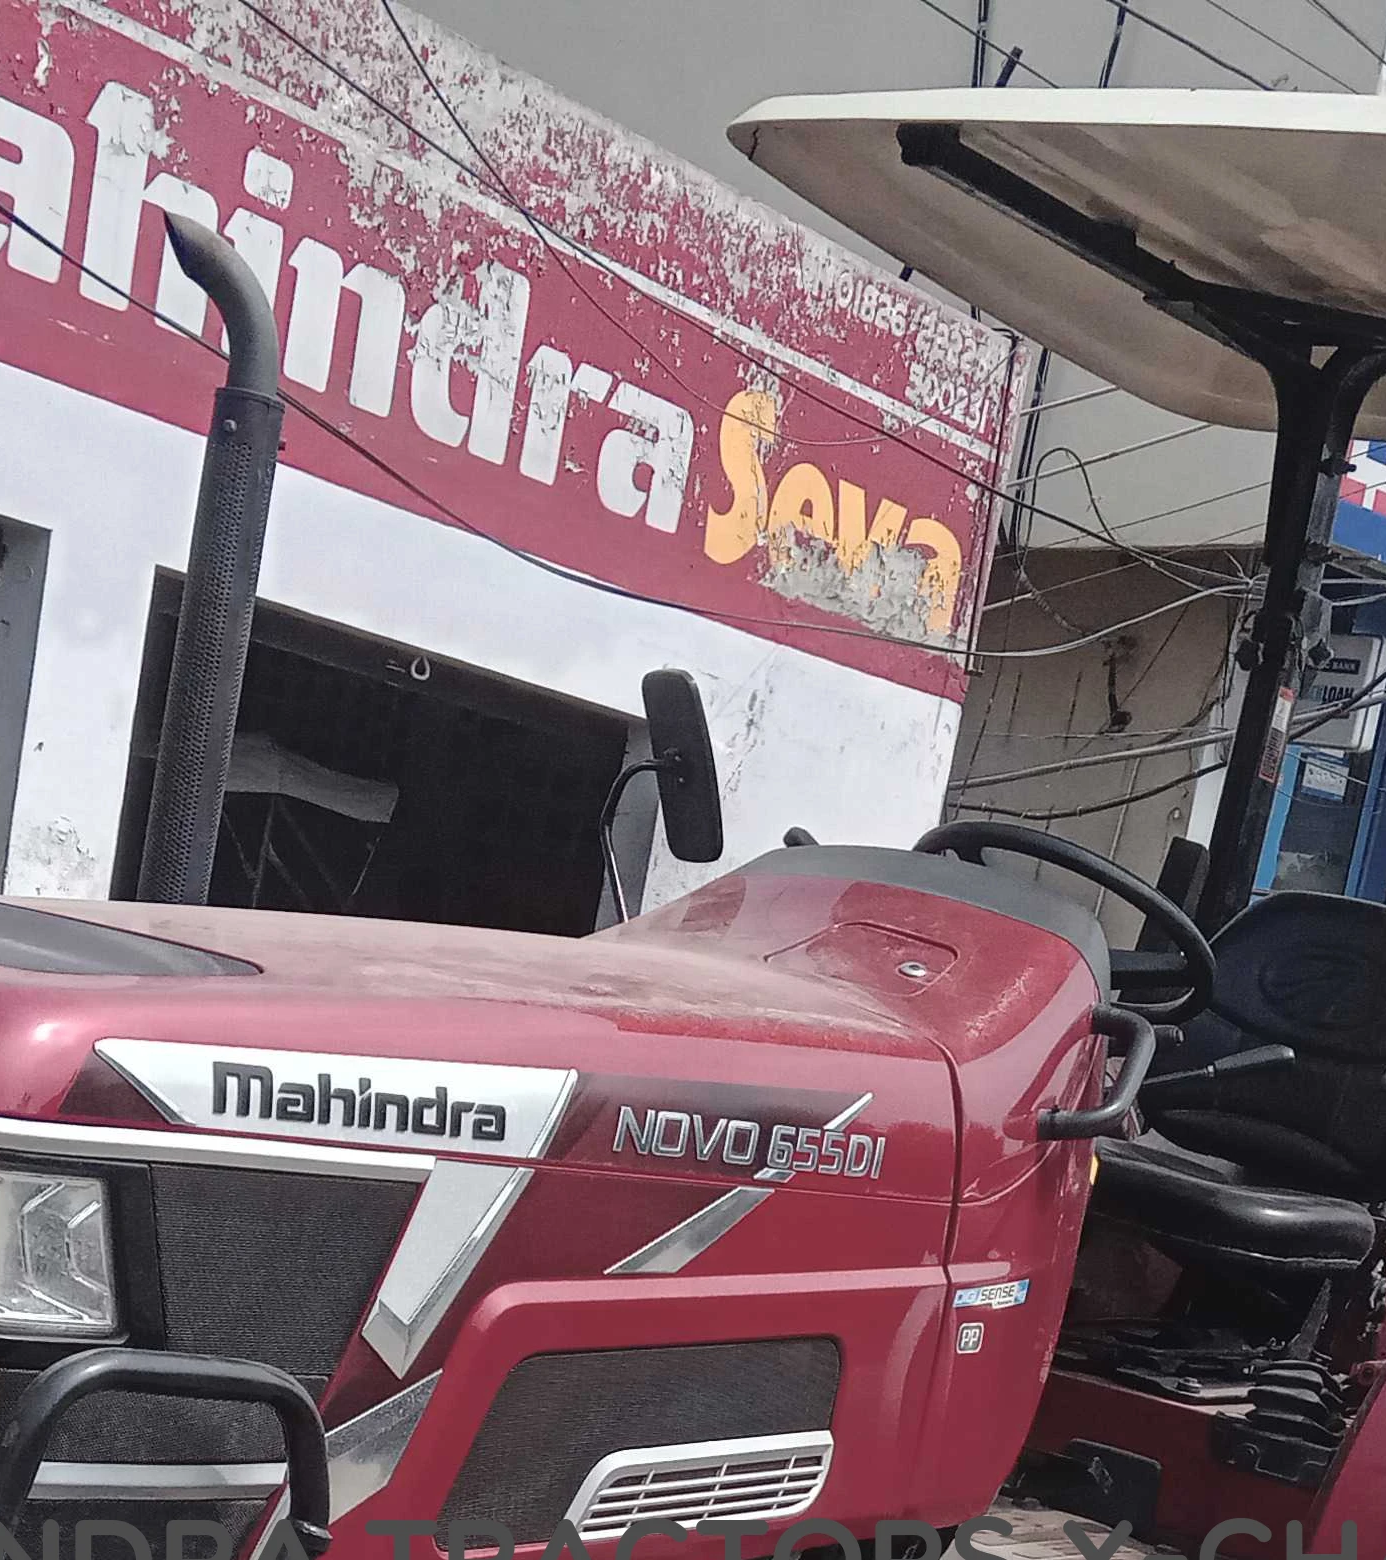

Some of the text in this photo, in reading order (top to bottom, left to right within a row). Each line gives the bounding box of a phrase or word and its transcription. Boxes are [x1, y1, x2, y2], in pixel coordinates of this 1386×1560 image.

[210, 1059, 507, 1144] Mahindra
[613, 1105, 887, 1181] NOVO 655DI
